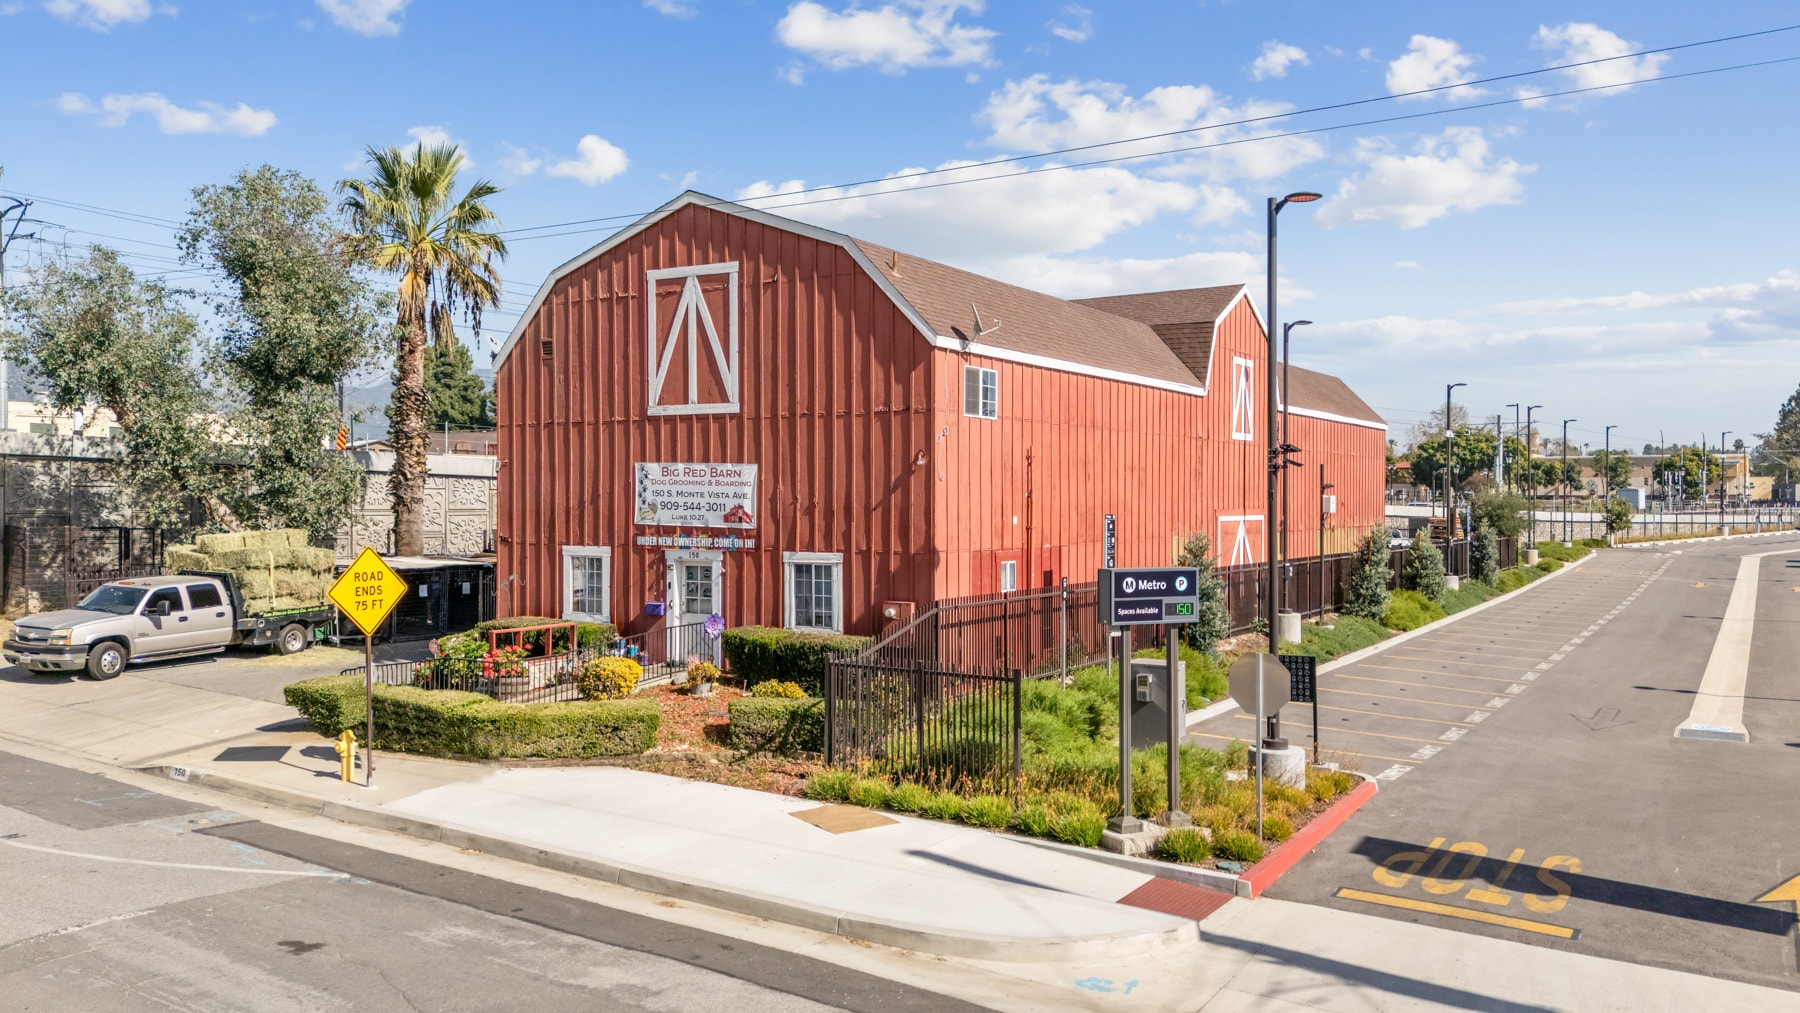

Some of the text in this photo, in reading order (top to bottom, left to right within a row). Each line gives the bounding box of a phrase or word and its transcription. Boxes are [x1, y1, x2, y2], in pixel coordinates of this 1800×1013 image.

[661, 467, 742, 478] BIG RED BARN
[666, 490, 674, 498] S.
[676, 490, 705, 498] MONTE
[707, 491, 730, 499] VISTA
[660, 501, 726, 512] 909-544-3011
[636, 536, 657, 546] UNDER
[658, 536, 673, 546] NEW
[714, 537, 733, 548] COME
[734, 538, 744, 548] ON
[745, 538, 755, 549] IN!
[689, 551, 700, 559] 150
[354, 571, 384, 582] ROAD
[1138, 579, 1167, 590] Metro
[355, 585, 383, 597] ENDS
[355, 599, 384, 611] 75 FT
[1176, 603, 1192, 615] 150
[1117, 607, 1135, 616] Spaces
[174, 767, 186, 777] 150
[1372, 837, 1583, 914] STOP
